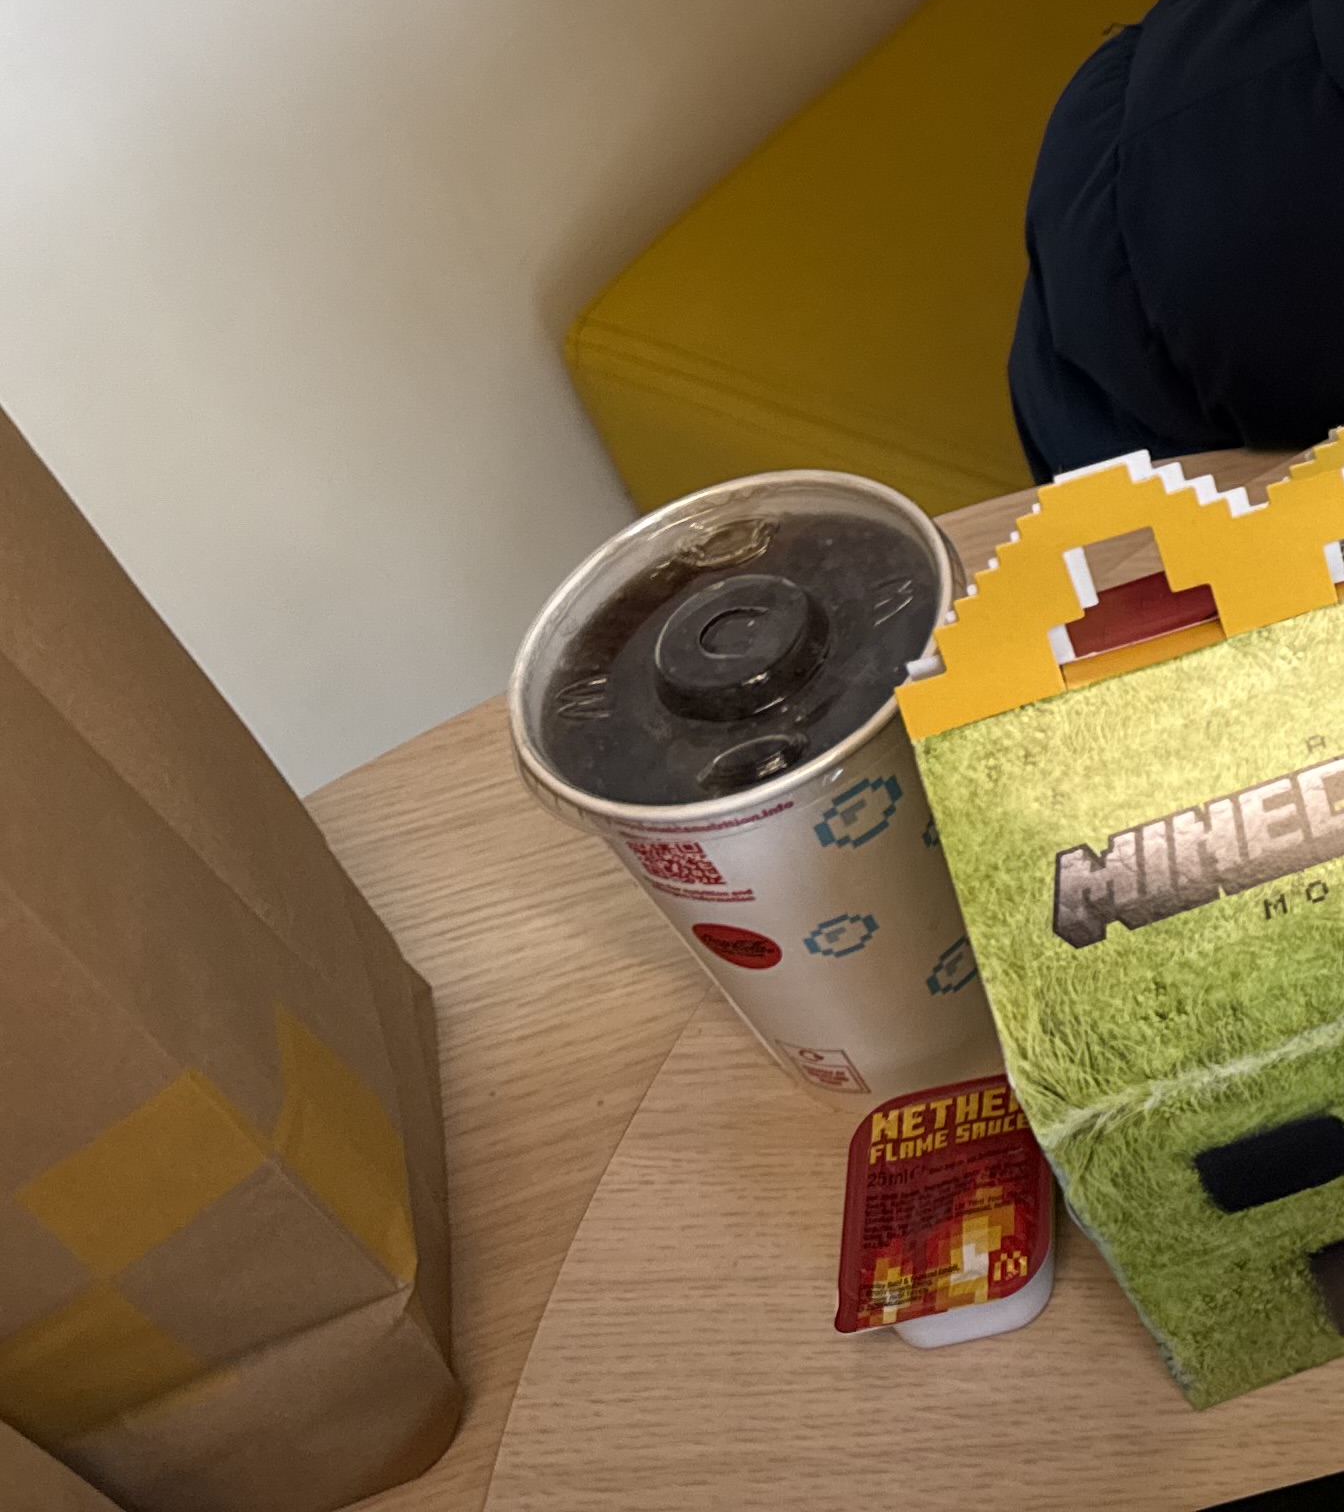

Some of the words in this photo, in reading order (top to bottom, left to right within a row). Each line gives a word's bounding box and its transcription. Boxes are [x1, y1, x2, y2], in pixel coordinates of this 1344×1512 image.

[1306, 734, 1327, 755] A
[869, 1129, 949, 1165] FLAME
[955, 1113, 1031, 1144] SAUCE
